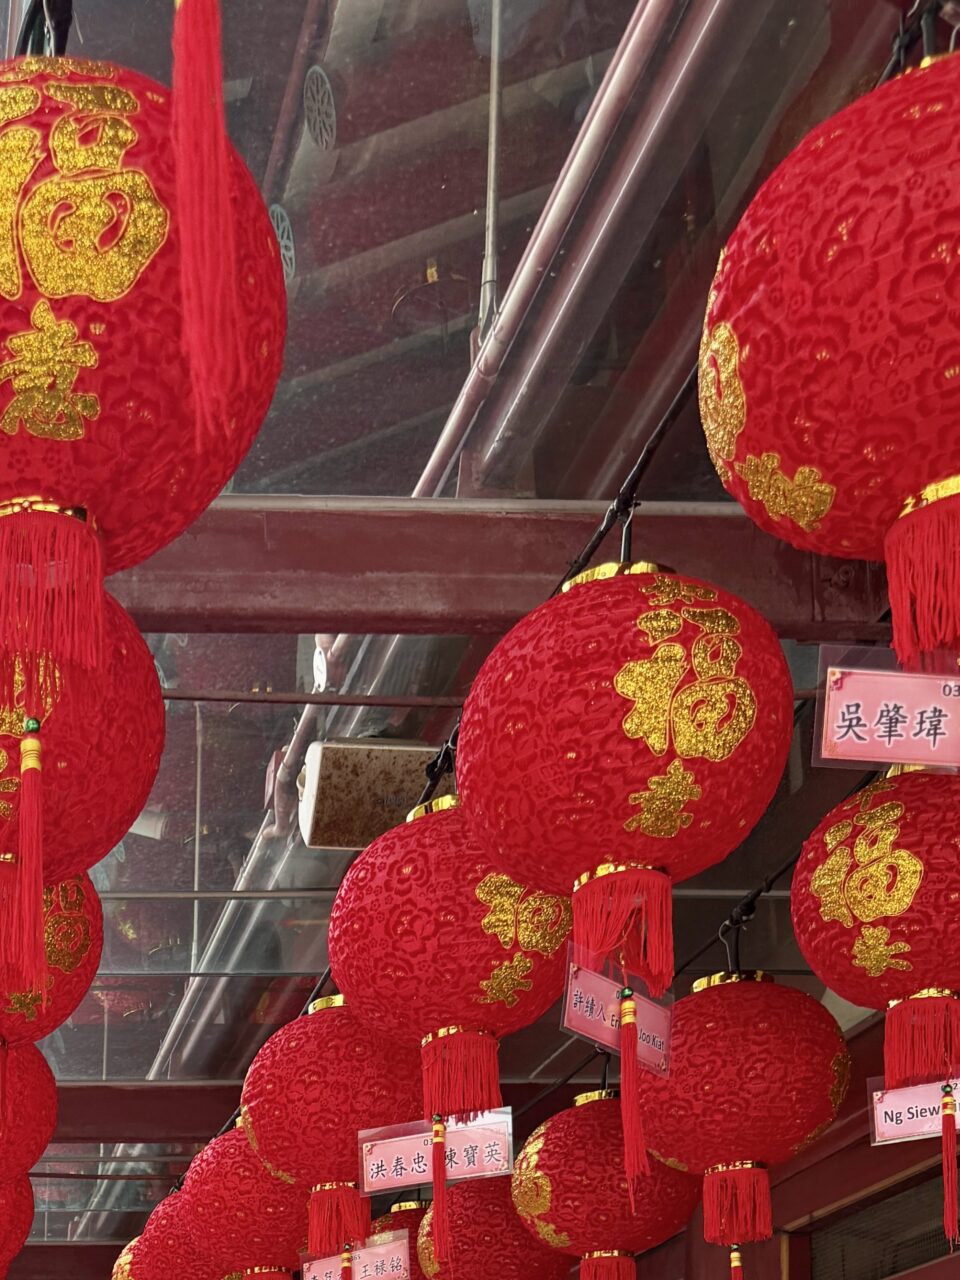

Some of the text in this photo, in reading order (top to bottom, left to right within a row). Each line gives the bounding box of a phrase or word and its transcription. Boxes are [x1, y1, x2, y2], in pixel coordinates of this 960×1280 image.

[614, 607, 757, 762] 福
[811, 801, 924, 928] 福
[884, 1110, 903, 1125] Ng
[907, 1105, 941, 1120] Siew
[370, 1152, 428, 1179] 洪春忠
